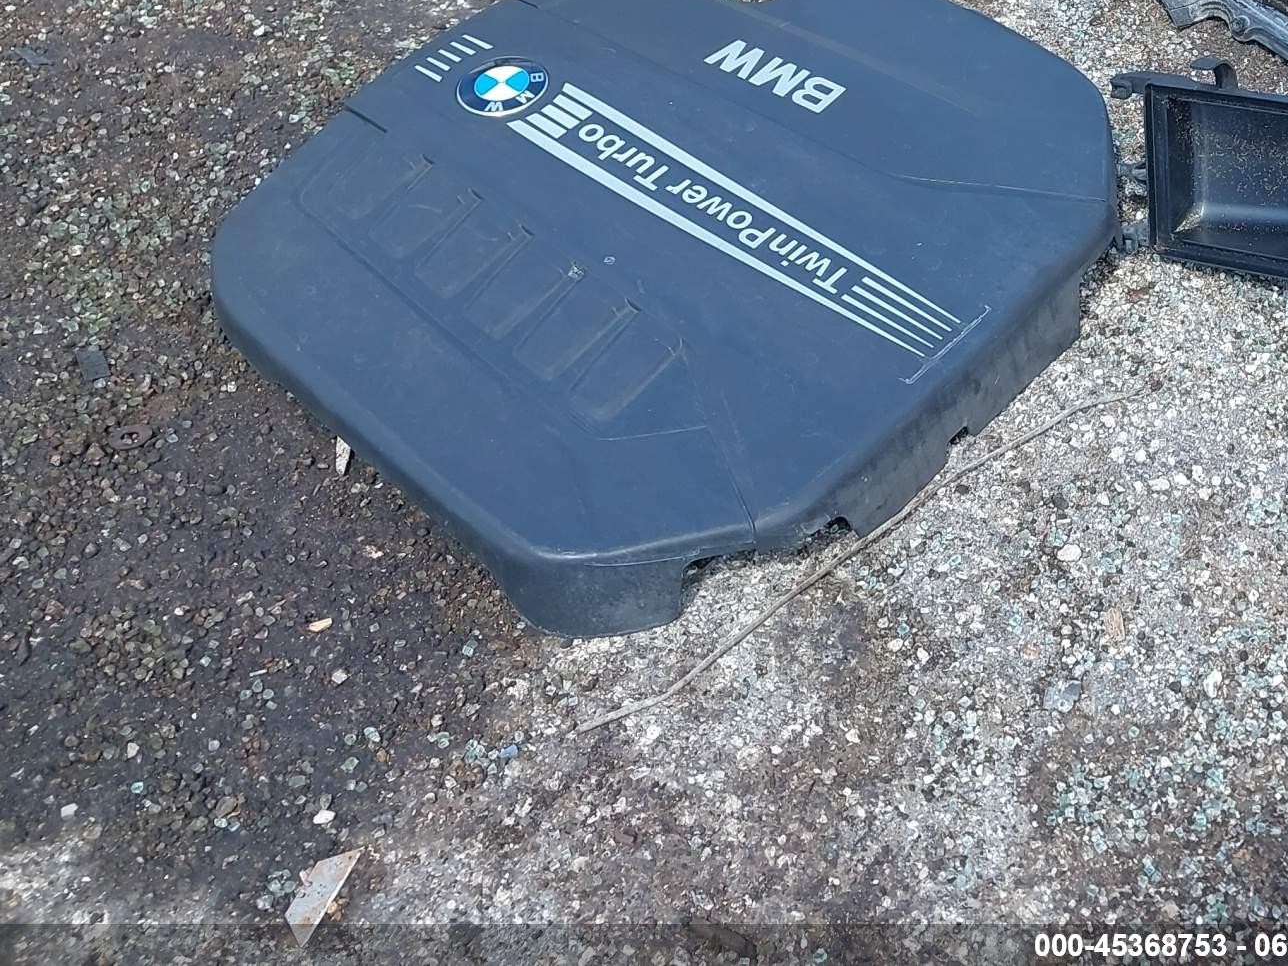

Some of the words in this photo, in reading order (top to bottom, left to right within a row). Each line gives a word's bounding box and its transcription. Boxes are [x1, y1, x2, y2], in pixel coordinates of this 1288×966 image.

[483, 72, 545, 112] BMW
[703, 39, 847, 114] BMW
[578, 123, 669, 191] Turbo
[665, 178, 848, 294] TwinPower
